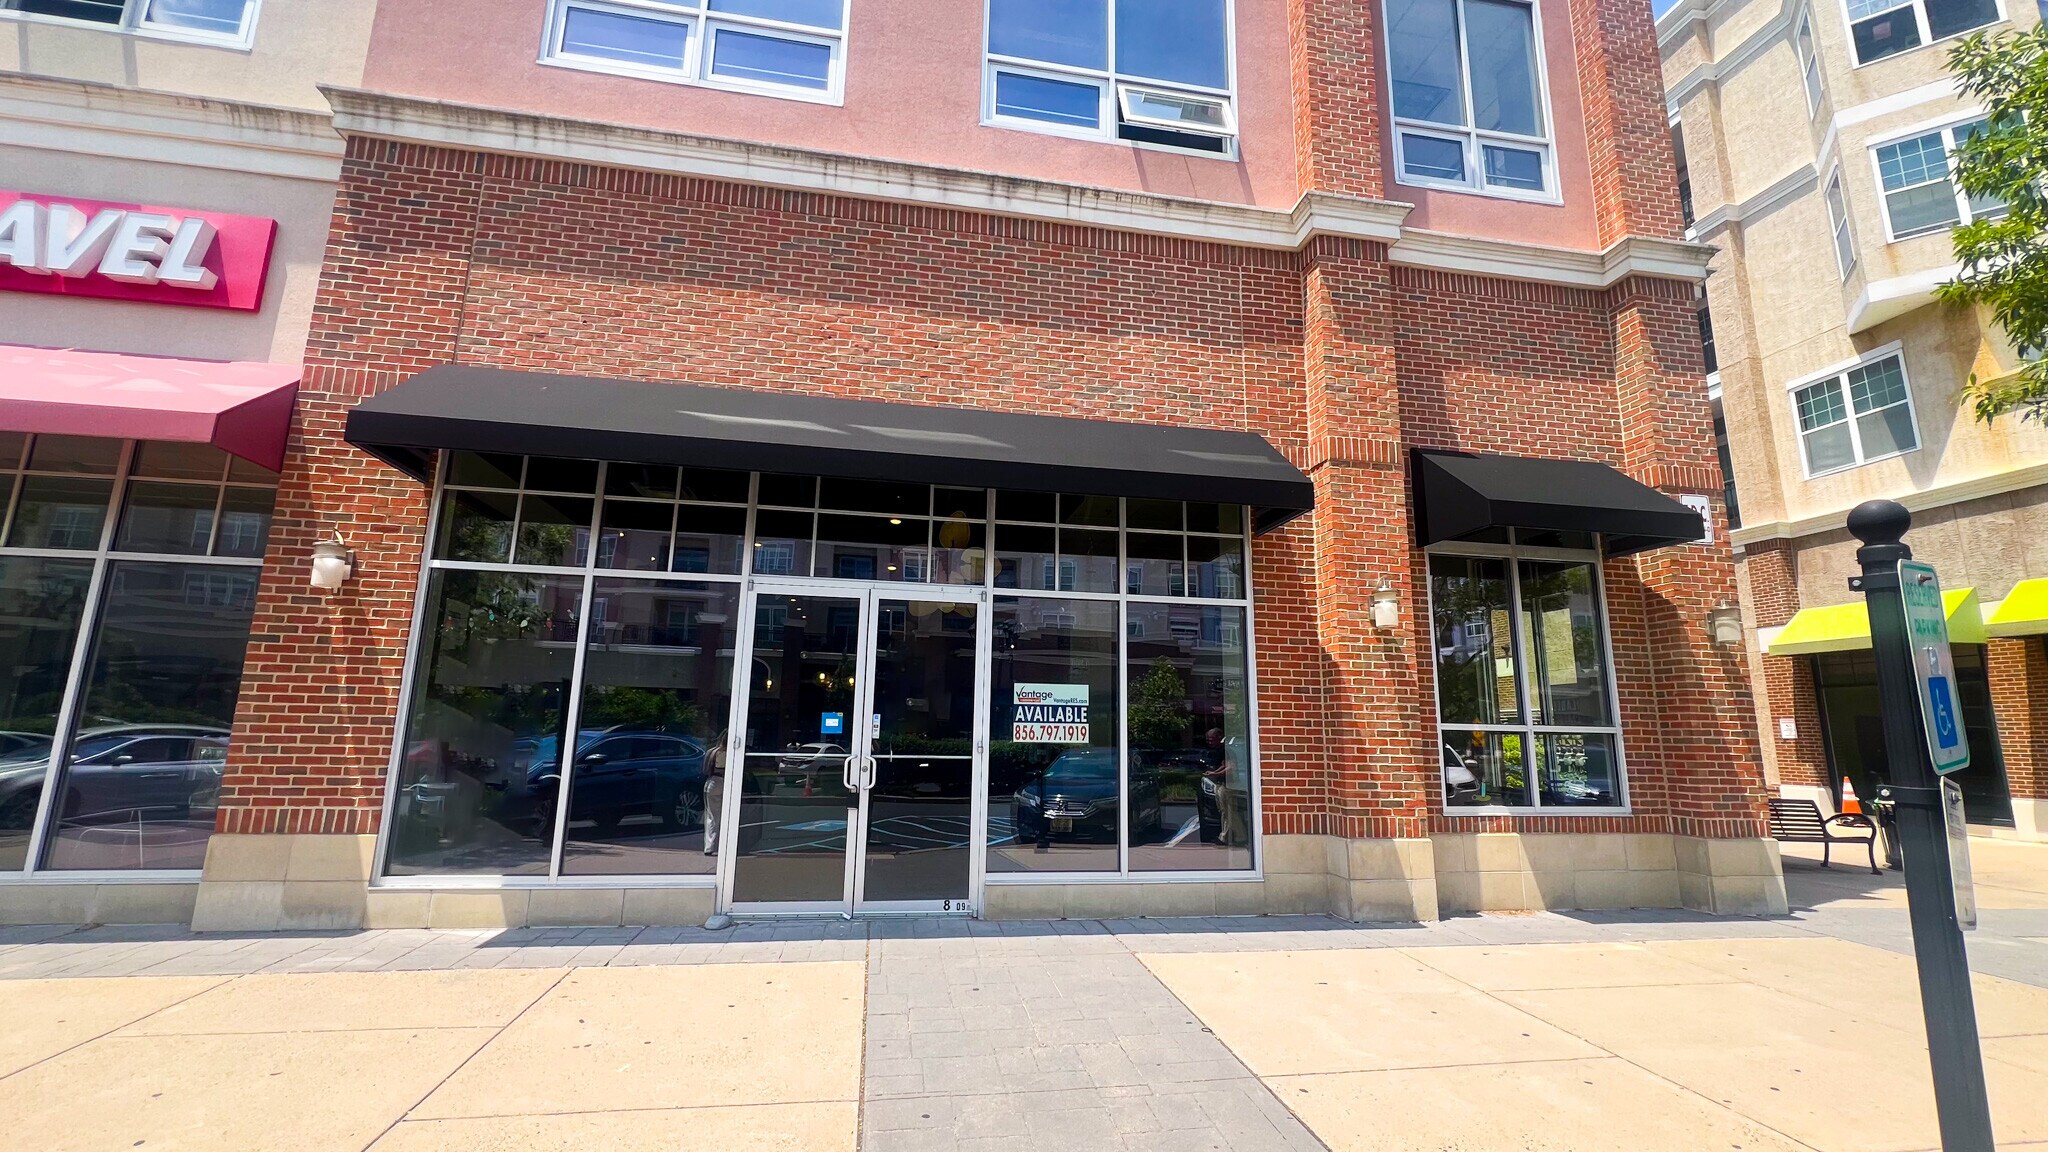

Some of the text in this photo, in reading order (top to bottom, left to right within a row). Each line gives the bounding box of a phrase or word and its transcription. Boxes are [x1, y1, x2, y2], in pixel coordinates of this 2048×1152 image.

[0, 200, 218, 291] AVEL
[1015, 705, 1088, 723] AVAILABLE
[1014, 725, 1087, 741] 856.797.1919
